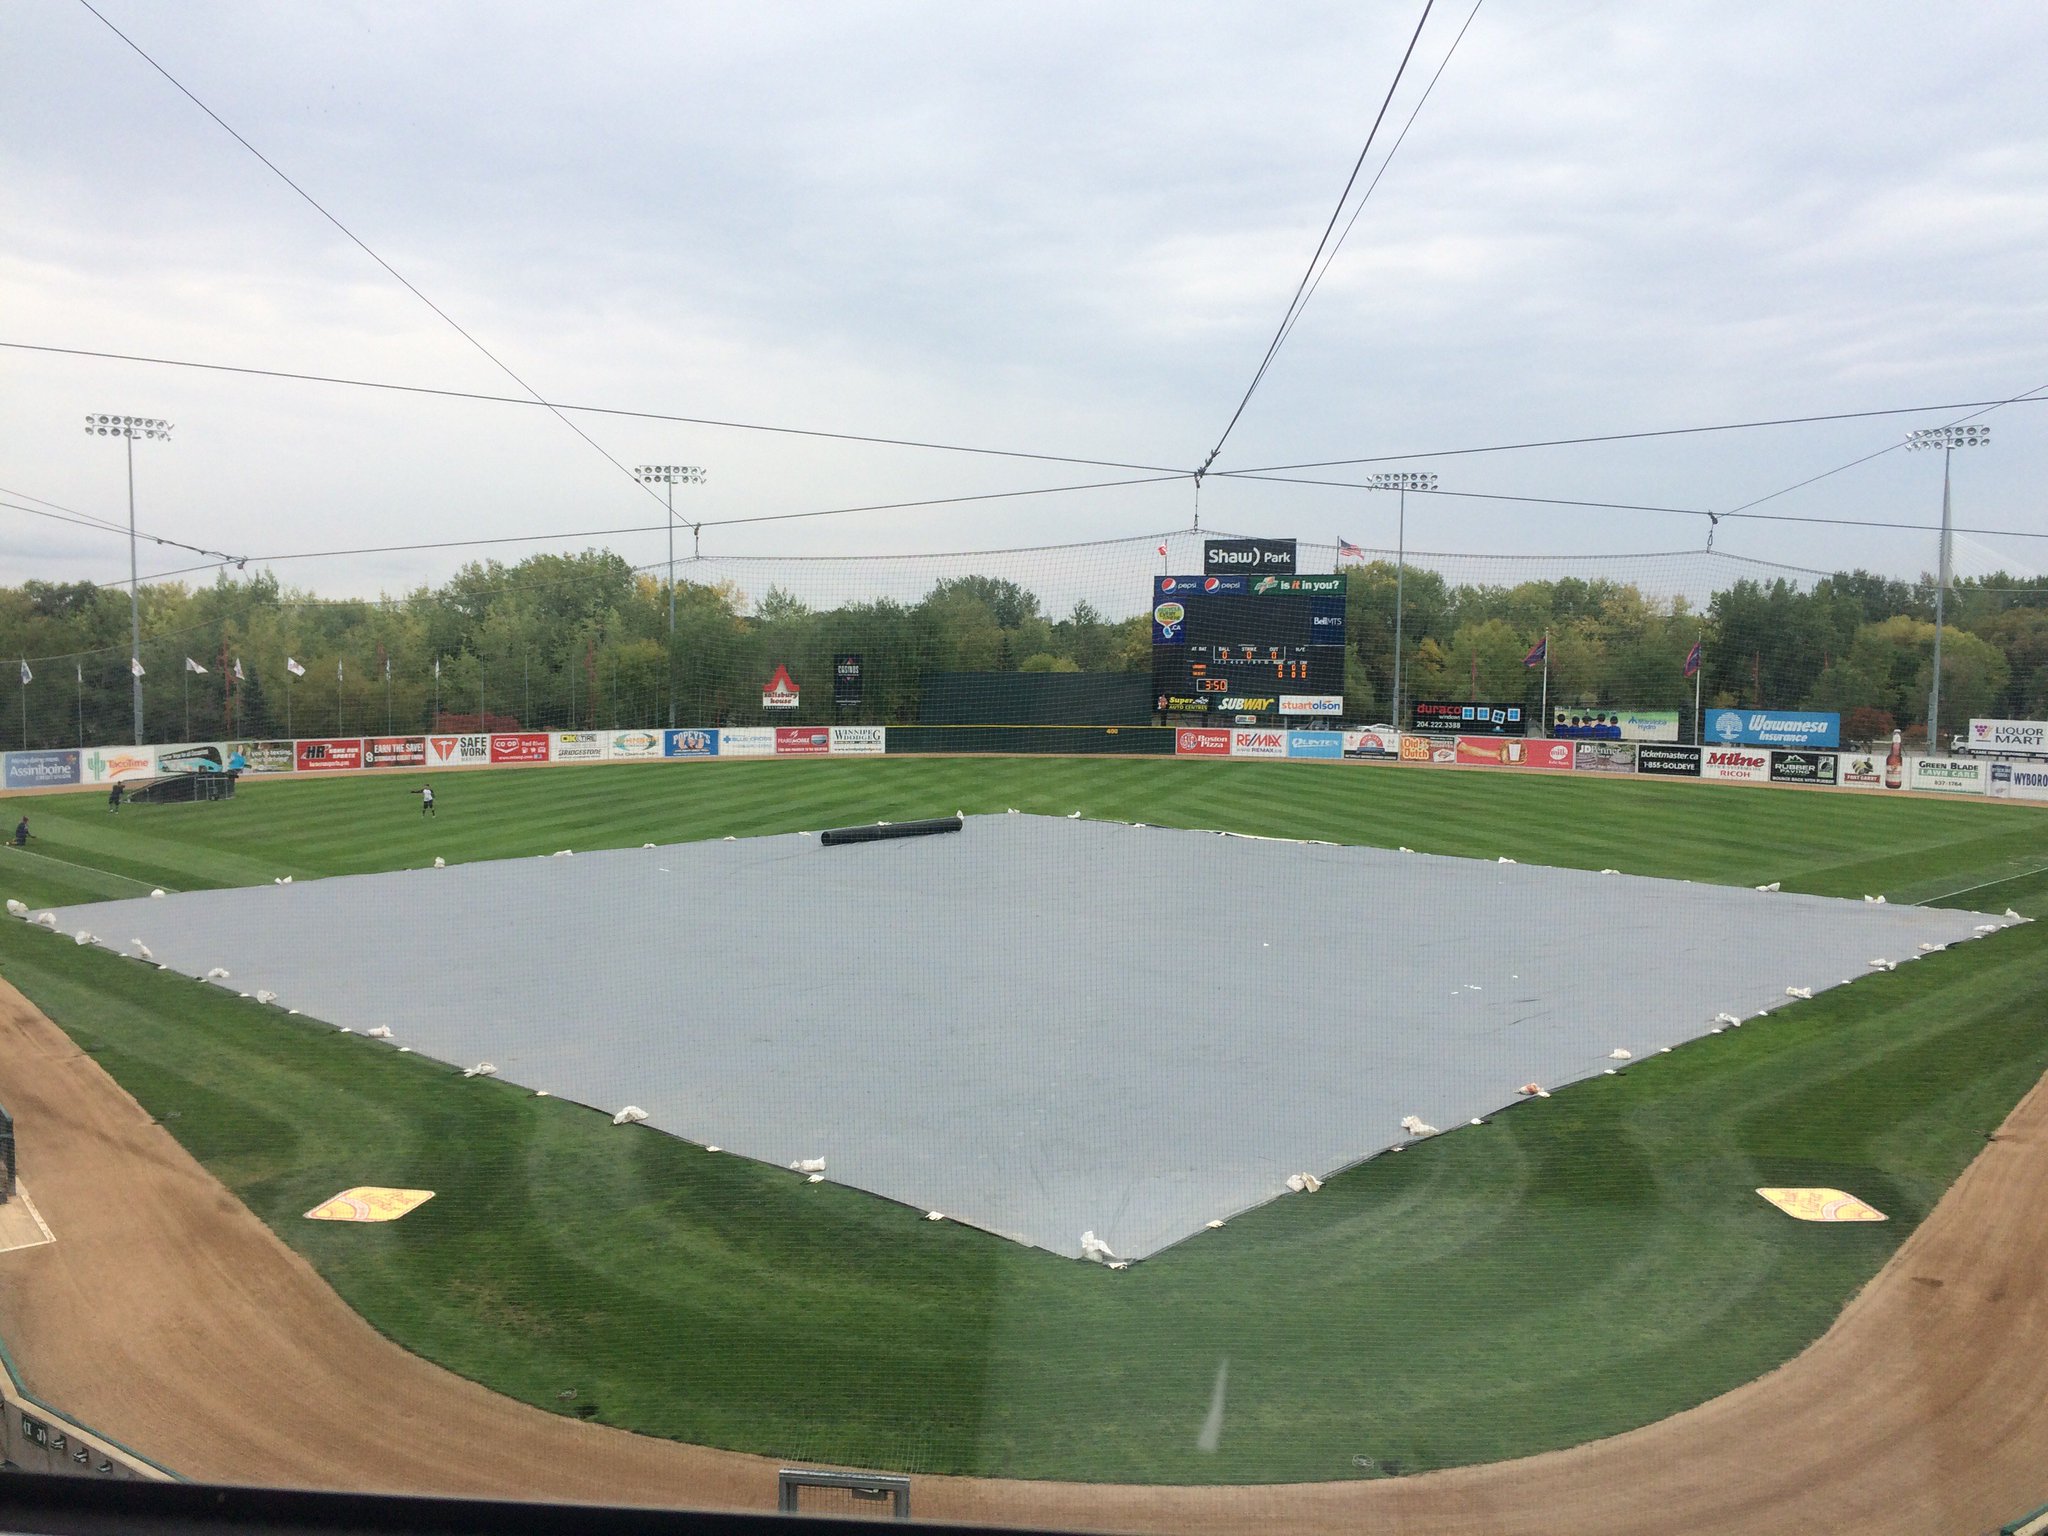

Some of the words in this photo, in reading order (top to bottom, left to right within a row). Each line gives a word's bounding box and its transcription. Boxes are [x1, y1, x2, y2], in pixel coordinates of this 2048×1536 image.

[1264, 552, 1290, 563] Park
[1177, 582, 1197, 590] pepsi
[1221, 582, 1240, 590] pepsi
[1280, 581, 1290, 590] is
[1292, 581, 1300, 590] it
[1302, 581, 1312, 590] in
[1314, 581, 1339, 593] you?
[1222, 651, 1227, 659] 0
[1247, 651, 1252, 659] 0
[1272, 651, 1277, 659] 0
[1169, 696, 1193, 704] Super
[1218, 697, 1275, 711] SUBWAY
[1417, 704, 1460, 714] duraco
[1638, 724, 1656, 732] Hydro
[1749, 715, 1828, 733] Wawanesa
[835, 729, 881, 741] WINNIPEG
[1996, 726, 2044, 736] LIQUOR
[460, 737, 487, 748] SAFE
[1197, 735, 1228, 743] Boston
[1237, 733, 1282, 747] RE/MAX
[1403, 738, 1419, 748] Old
[1995, 735, 2044, 745] MART
[374, 745, 391, 754] EARN
[392, 744, 404, 753] THE
[461, 747, 487, 757] WORK
[1403, 749, 1428, 759] Dutch
[1641, 750, 1699, 761] ticketmaster.ca
[1706, 752, 1766, 768] Milne
[108, 759, 149, 769] TacoTime
[1644, 761, 1695, 770] 1-855-GOLDEYE
[1775, 763, 1816, 771] RUBBER
[1919, 761, 1947, 769] GREEN
[1951, 762, 1979, 771] BLADE
[9, 763, 72, 777] Assiniboine
[1952, 770, 1976, 778] CARE
